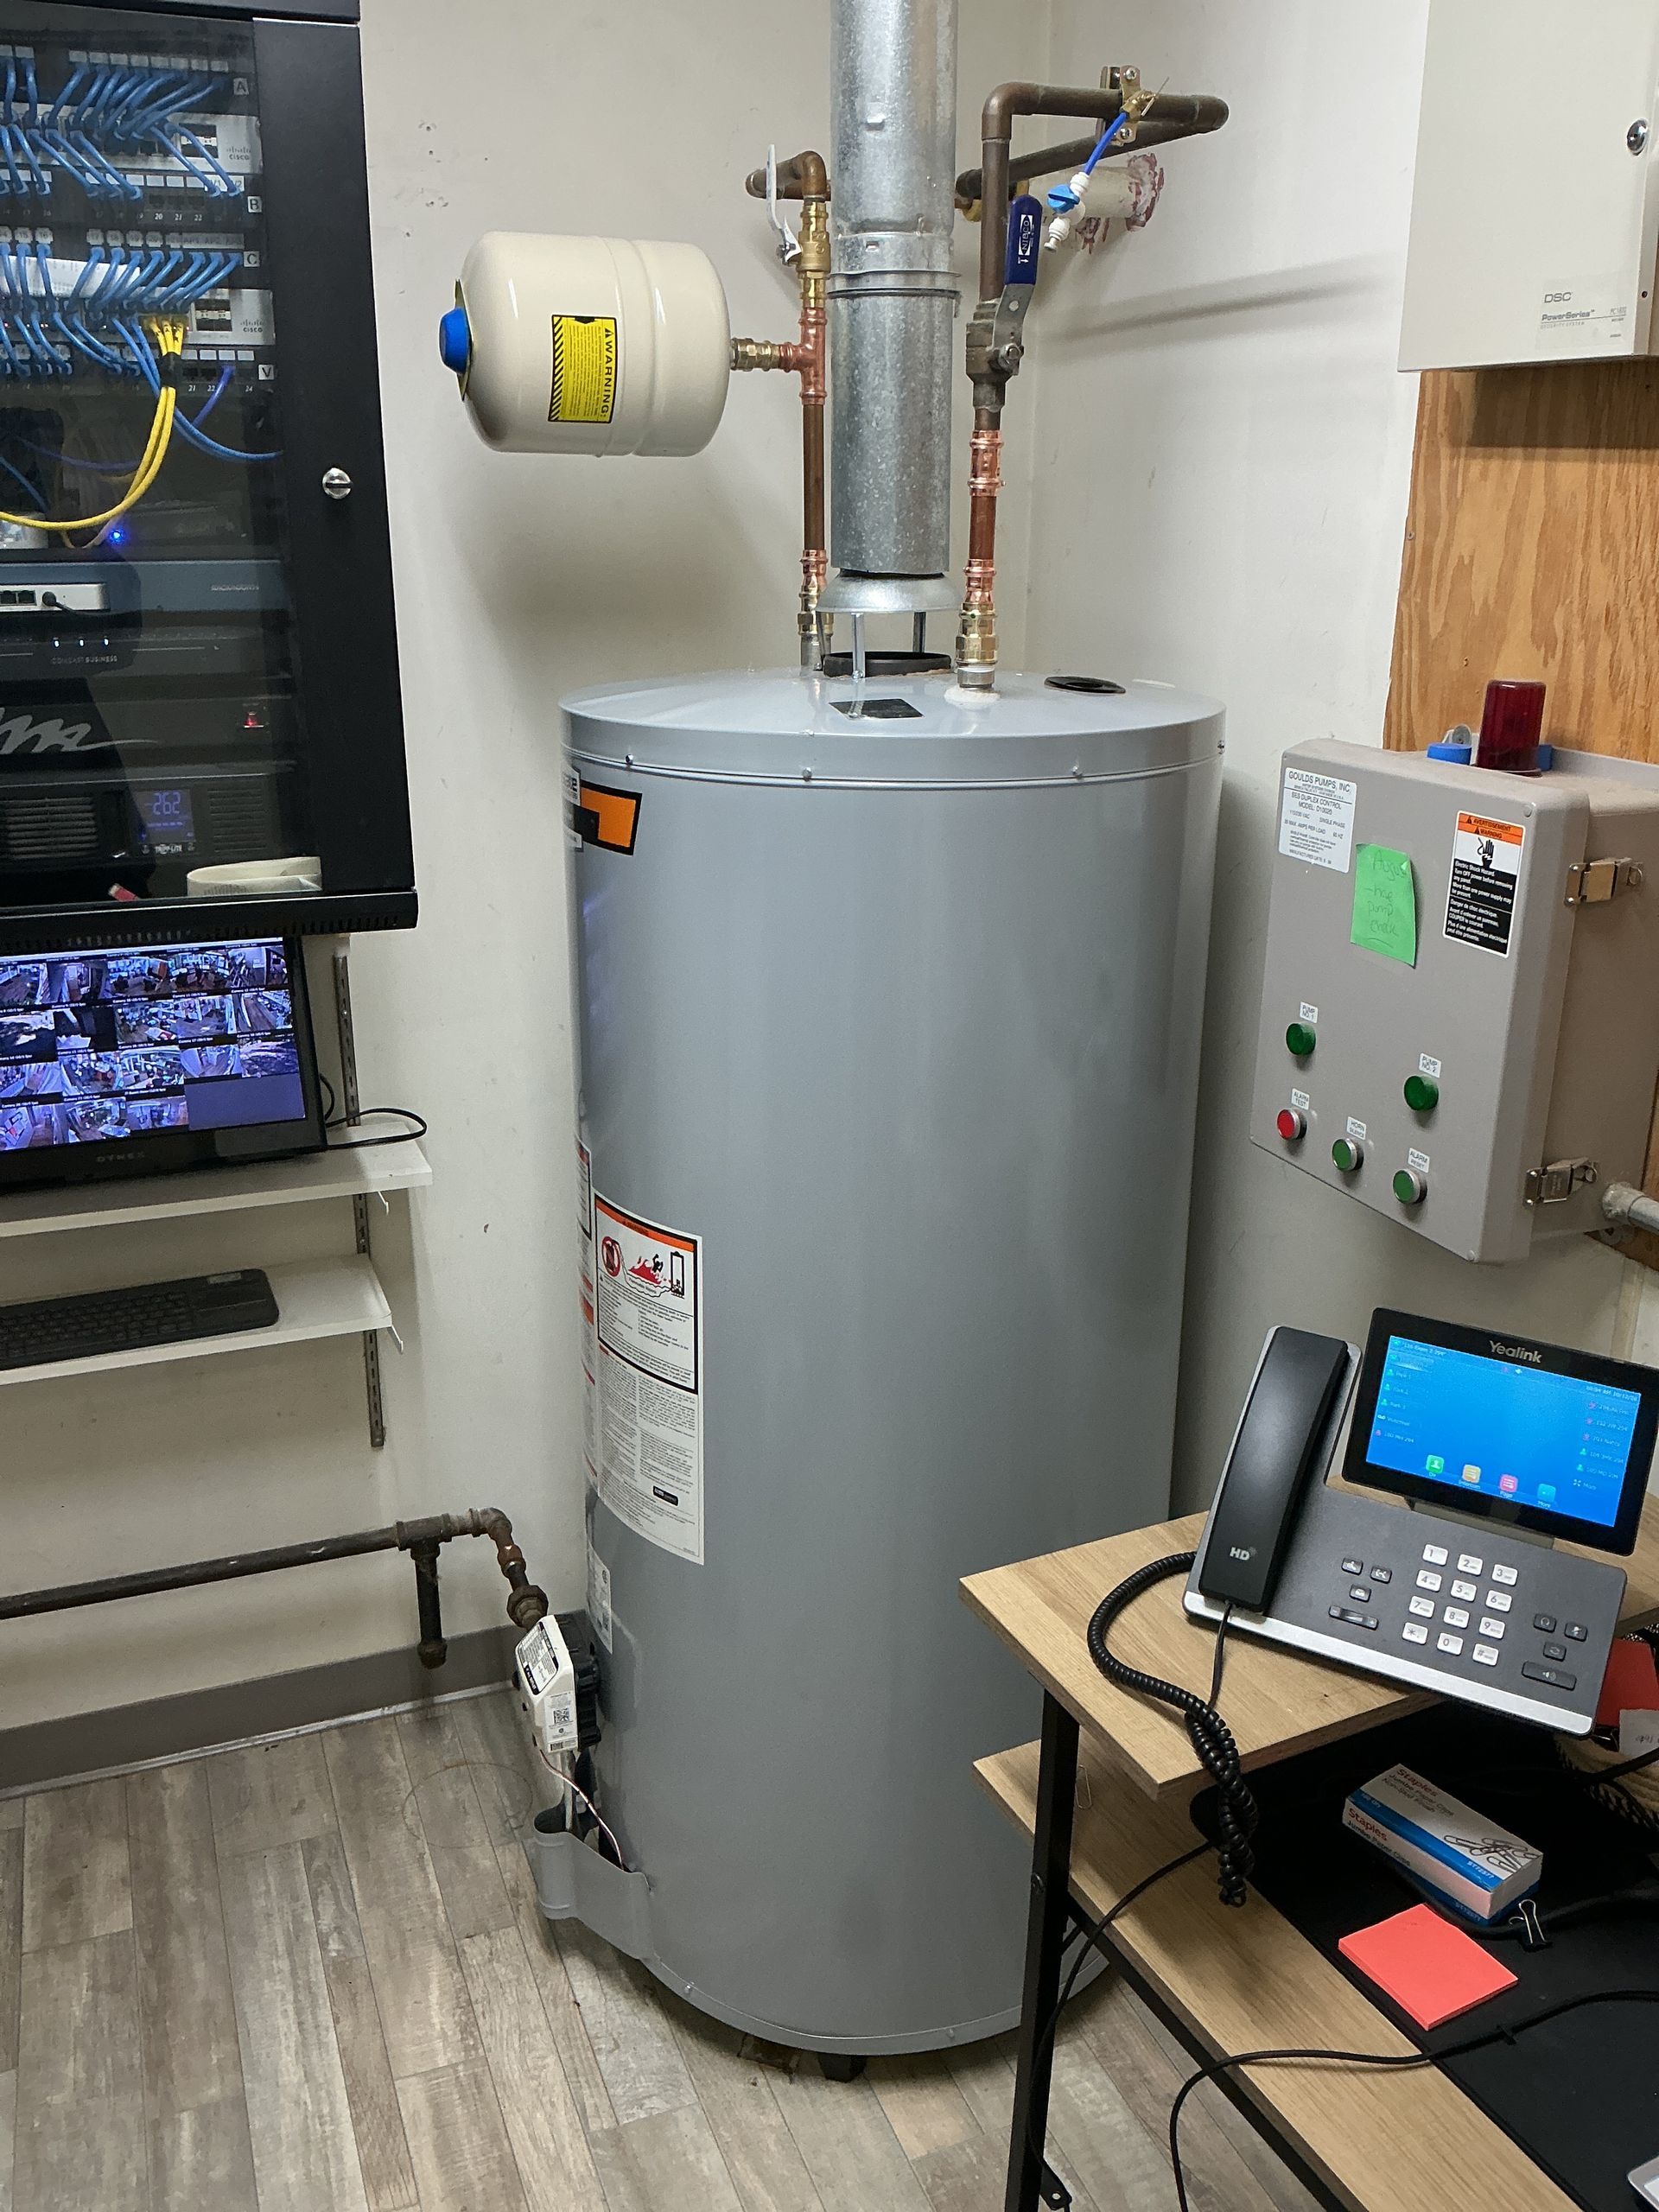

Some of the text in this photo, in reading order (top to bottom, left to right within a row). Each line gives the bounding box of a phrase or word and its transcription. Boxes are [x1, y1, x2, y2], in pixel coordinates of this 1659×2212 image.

[237, 81, 247, 92] A
[250, 200, 258, 210] B
[1021, 220, 1031, 251] NIBCO
[247, 253, 257, 264] C
[1544, 292, 1572, 303] DSC
[262, 367, 271, 378] V
[1289, 771, 1313, 783] GOULDS
[1314, 777, 1337, 790] PUMPS,
[1299, 801, 1314, 810] MODEL:
[1301, 794, 1318, 803] DUPLEX
[1319, 798, 1341, 809] CONTROL
[1471, 819, 1511, 832] AVERTISSEMENT
[1480, 829, 1503, 839] WARNING
[1450, 899, 1463, 907] Danger
[1448, 912, 1464, 921] COUPER
[1302, 1005, 1315, 1014] PUMP
[1422, 1056, 1438, 1066] PUMP
[1294, 1091, 1309, 1103] ALARM
[1295, 1098, 1306, 1107] TEST
[1351, 1121, 1365, 1131] HORN
[1410, 1151, 1427, 1163] ALARM
[1410, 1160, 1426, 1169] RESET
[1489, 1340, 1542, 1364] Yealink
[1230, 1547, 1251, 1561] HD
[1464, 1559, 1470, 1567] 2
[1497, 1568, 1503, 1577] 3
[1396, 1768, 1439, 1797] Staples
[1389, 1774, 1414, 1791] Jumbo
[1414, 1789, 1436, 1804] Paper
[1348, 1808, 1388, 1842] Staples
[1348, 1821, 1411, 1866] Jumbo Paper Clips
